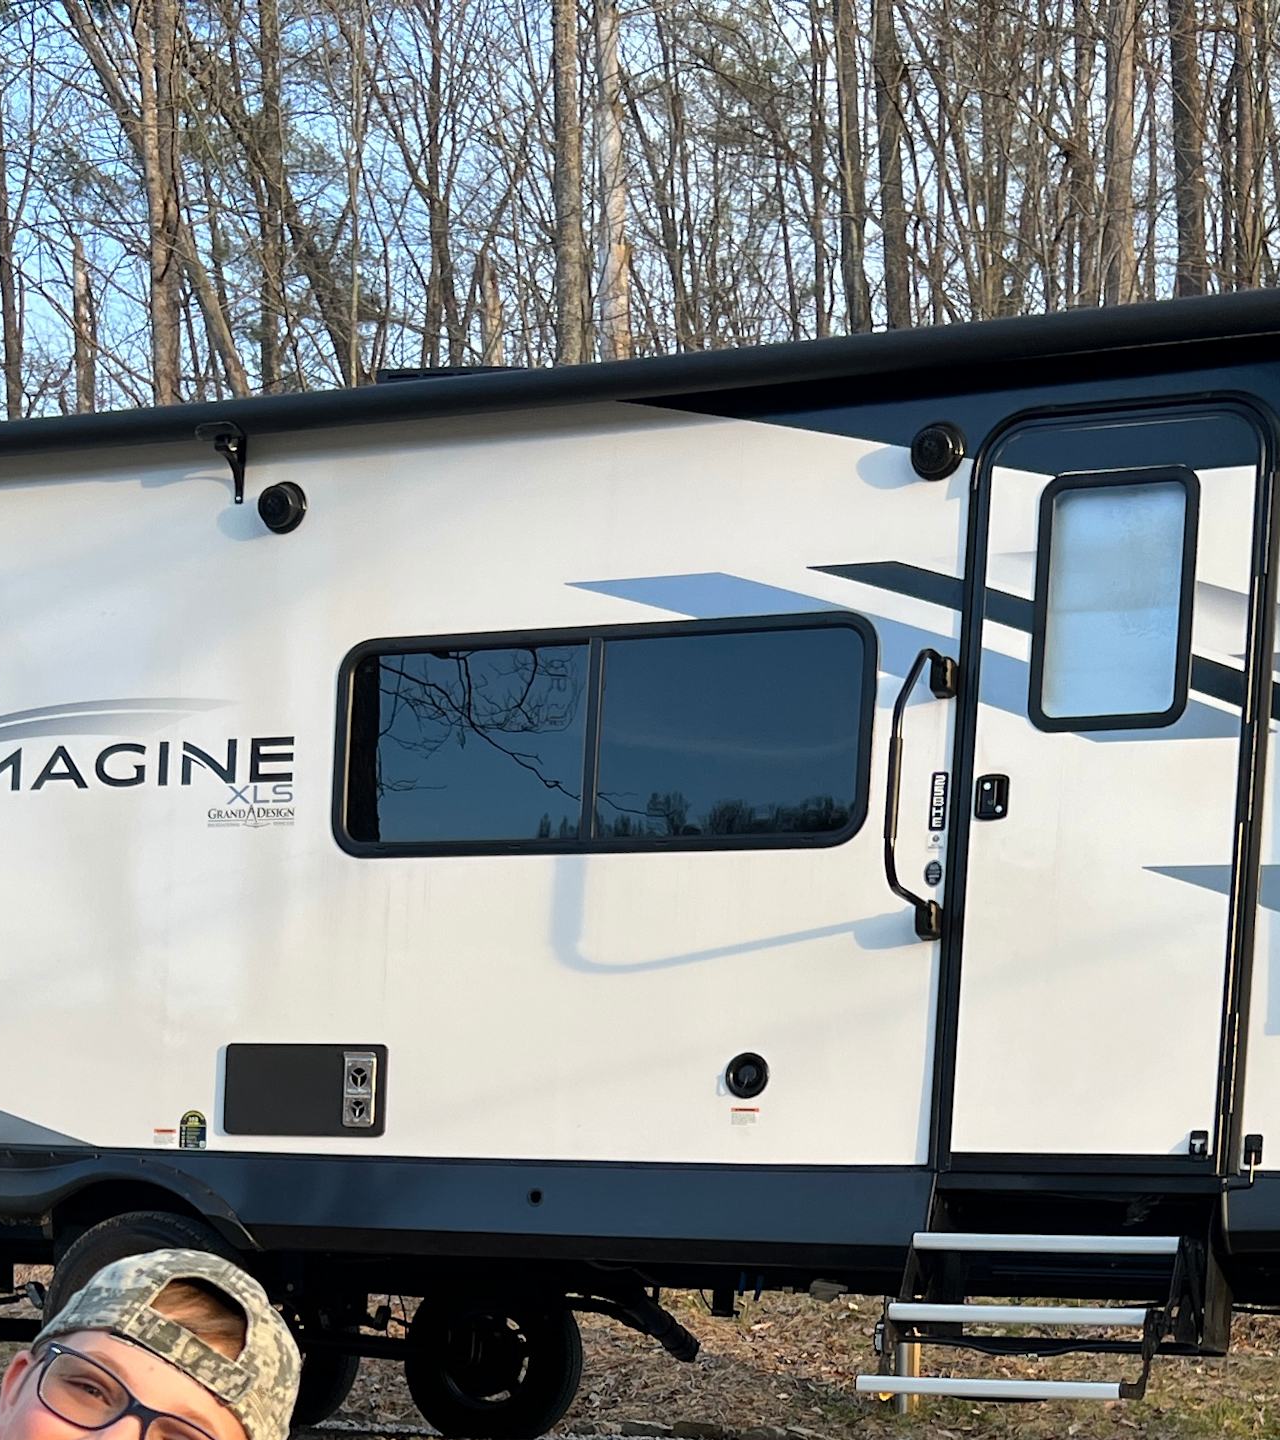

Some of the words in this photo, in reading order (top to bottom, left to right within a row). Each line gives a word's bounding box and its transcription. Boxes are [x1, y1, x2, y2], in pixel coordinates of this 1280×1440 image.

[226, 784, 294, 805] XLS
[207, 808, 246, 820] GRAND
[256, 807, 295, 819] DESIGN
